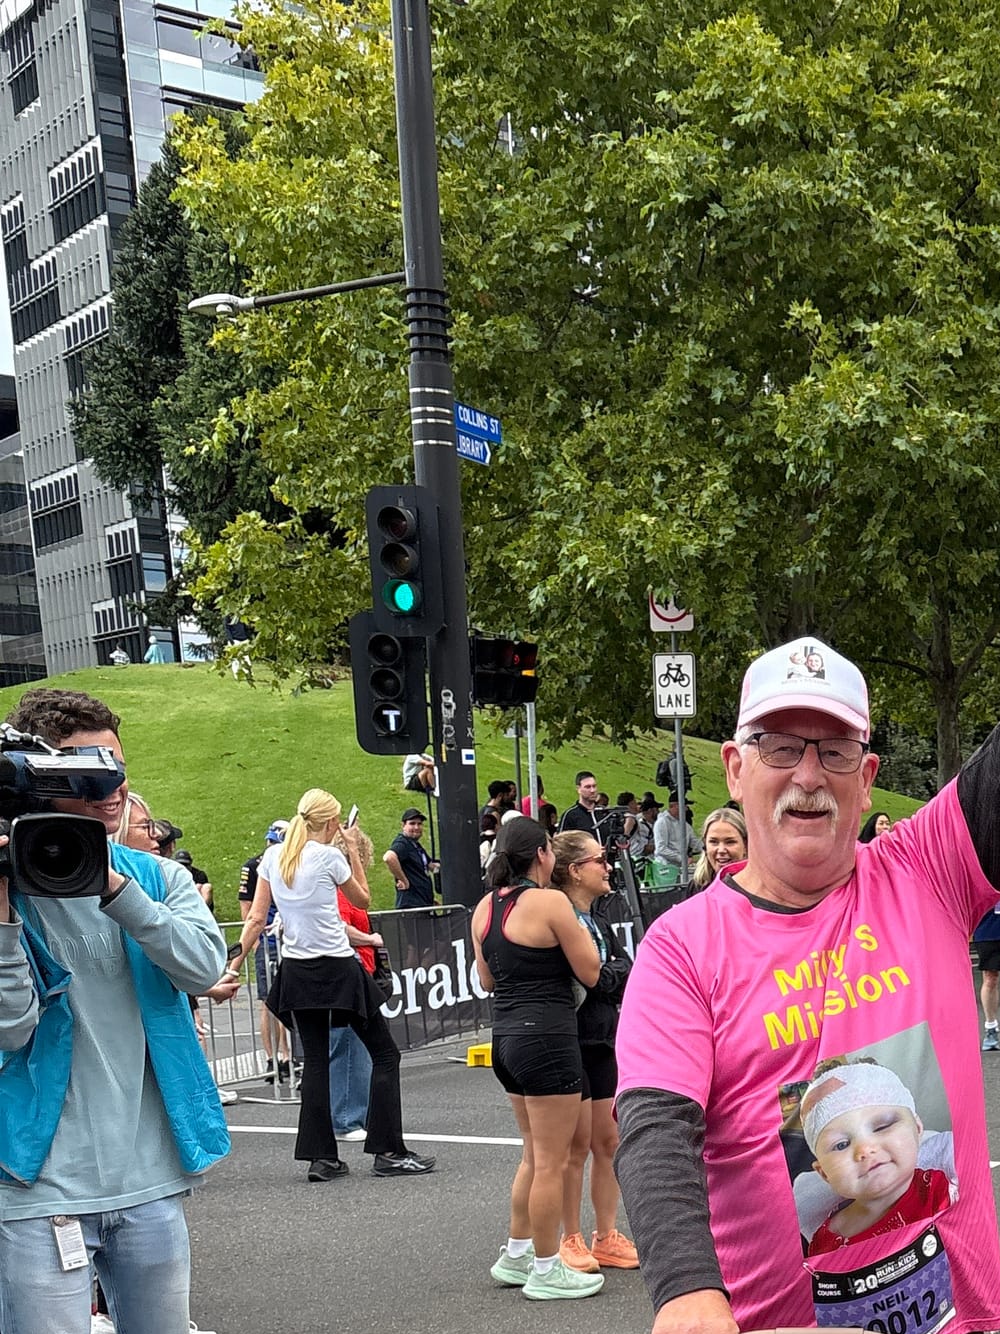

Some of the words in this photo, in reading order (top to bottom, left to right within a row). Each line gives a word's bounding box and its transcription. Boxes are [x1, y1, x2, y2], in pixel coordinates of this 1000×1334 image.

[458, 405, 489, 431] COLLINS
[490, 418, 499, 435] ST
[658, 693, 692, 708] LANE
[379, 938, 495, 1019] eral
[762, 966, 911, 1051] Mision
[876, 1265, 895, 1279] RUN
[897, 1252, 917, 1267] KIDS
[818, 1282, 838, 1290] SHORT
[872, 1290, 910, 1314] NEIL
